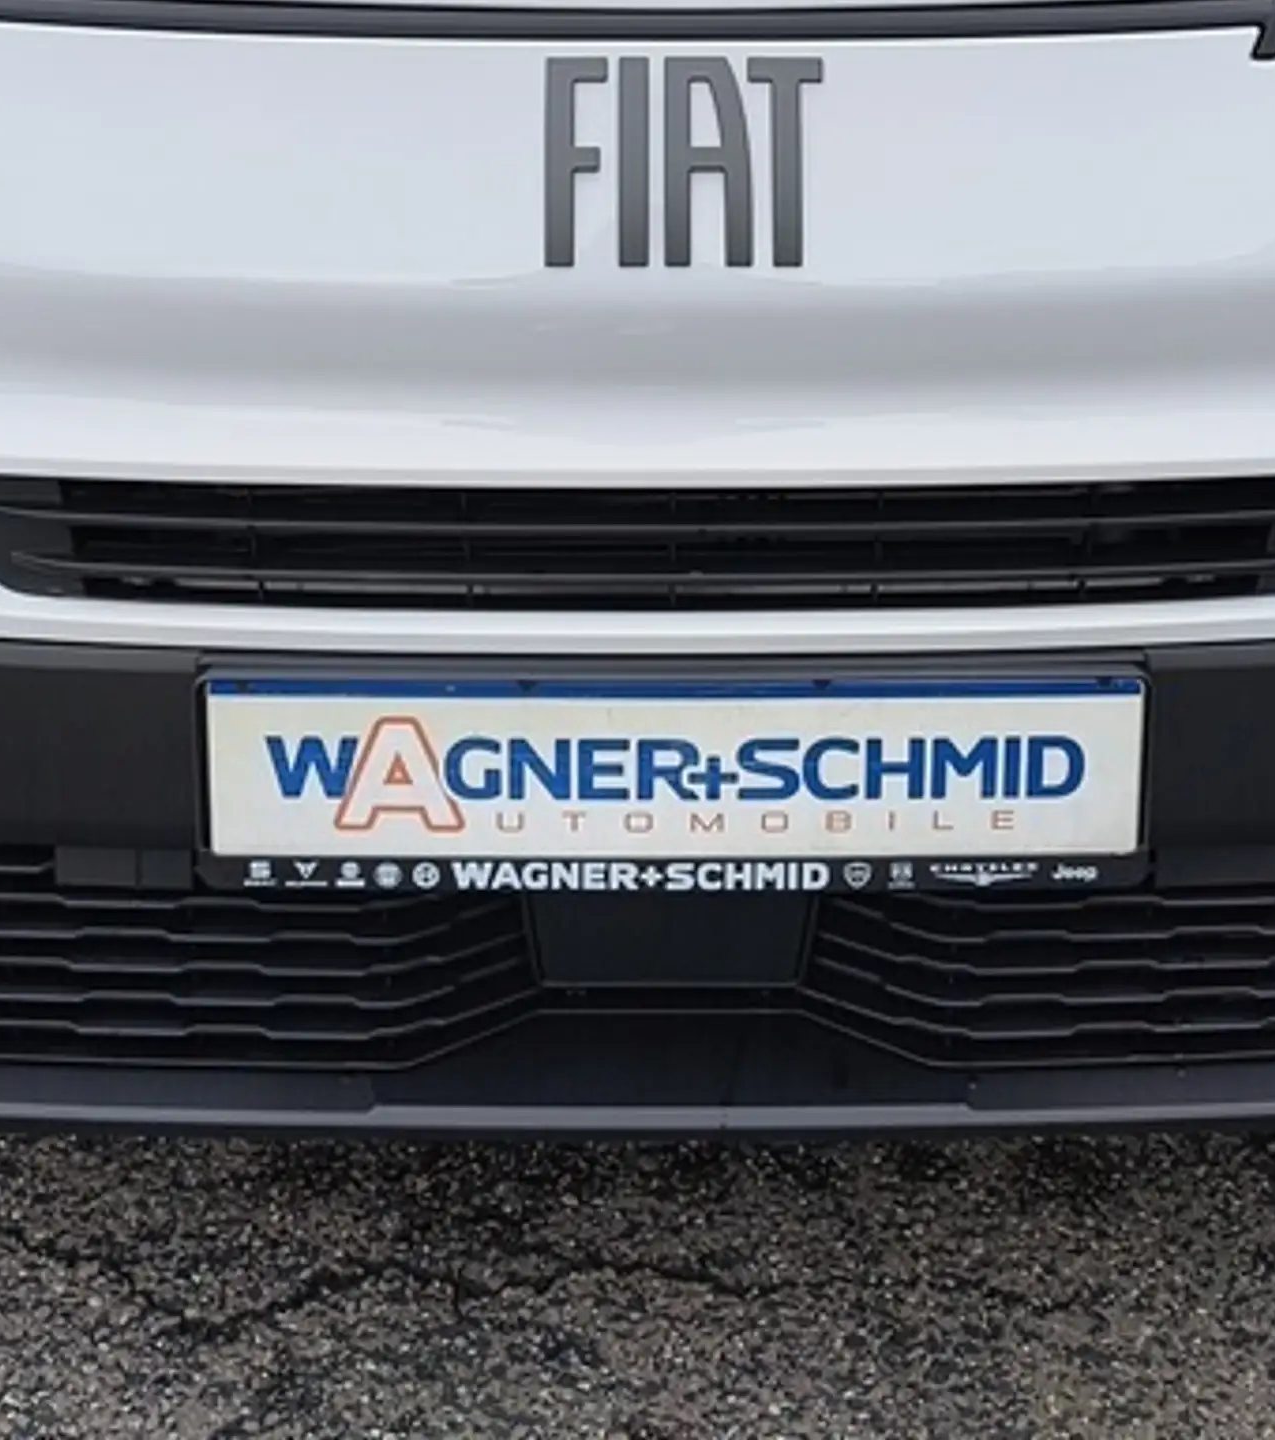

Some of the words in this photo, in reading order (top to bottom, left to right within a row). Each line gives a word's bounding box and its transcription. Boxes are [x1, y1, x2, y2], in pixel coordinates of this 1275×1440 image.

[543, 55, 825, 268] FIAT
[265, 715, 1085, 831] WAGNER+SCHMID
[452, 861, 829, 891] WAGNER+SCHMID
[1051, 863, 1099, 882] Jeep
